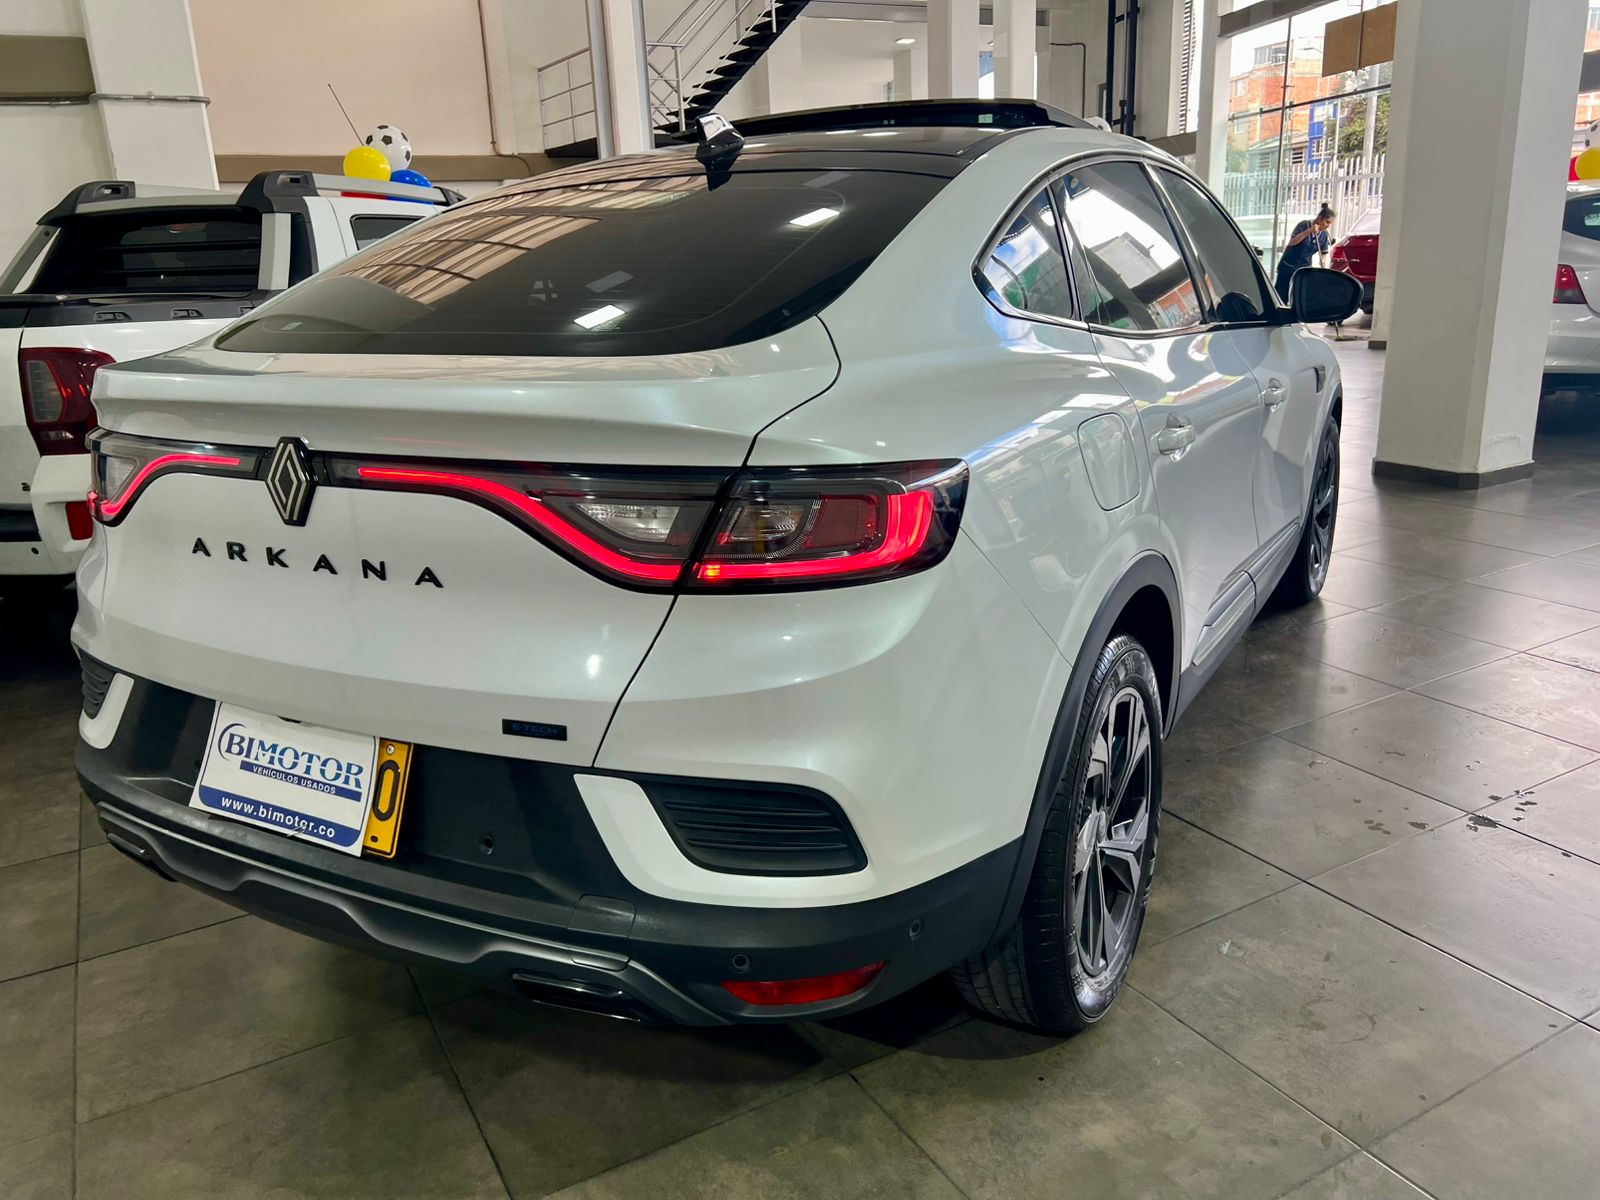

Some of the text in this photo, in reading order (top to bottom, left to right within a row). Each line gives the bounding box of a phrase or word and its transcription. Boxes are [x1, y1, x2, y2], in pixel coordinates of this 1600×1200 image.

[192, 537, 444, 588] ARKANA
[225, 733, 364, 789] BIMOTOR
[301, 778, 336, 794] USADOS
[221, 796, 335, 838] www.bimotor.co
